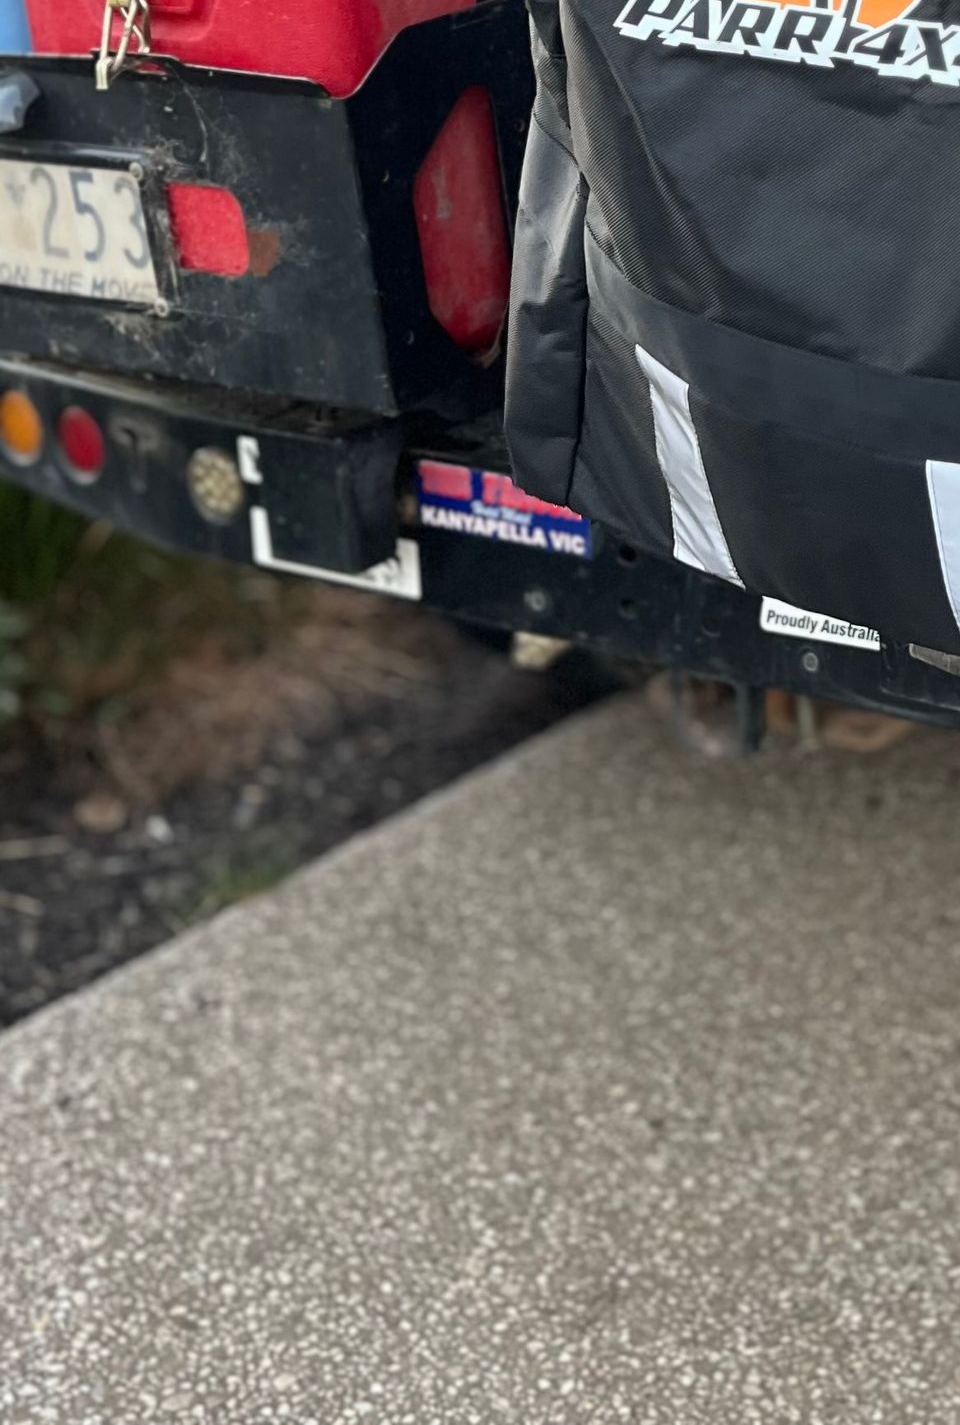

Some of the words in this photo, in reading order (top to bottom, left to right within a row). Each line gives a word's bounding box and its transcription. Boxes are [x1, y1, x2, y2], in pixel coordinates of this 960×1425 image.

[40, 267, 82, 294] THE
[420, 503, 547, 549] KANYAPELLA
[550, 529, 586, 556] VIC
[766, 609, 818, 634] Proudly
